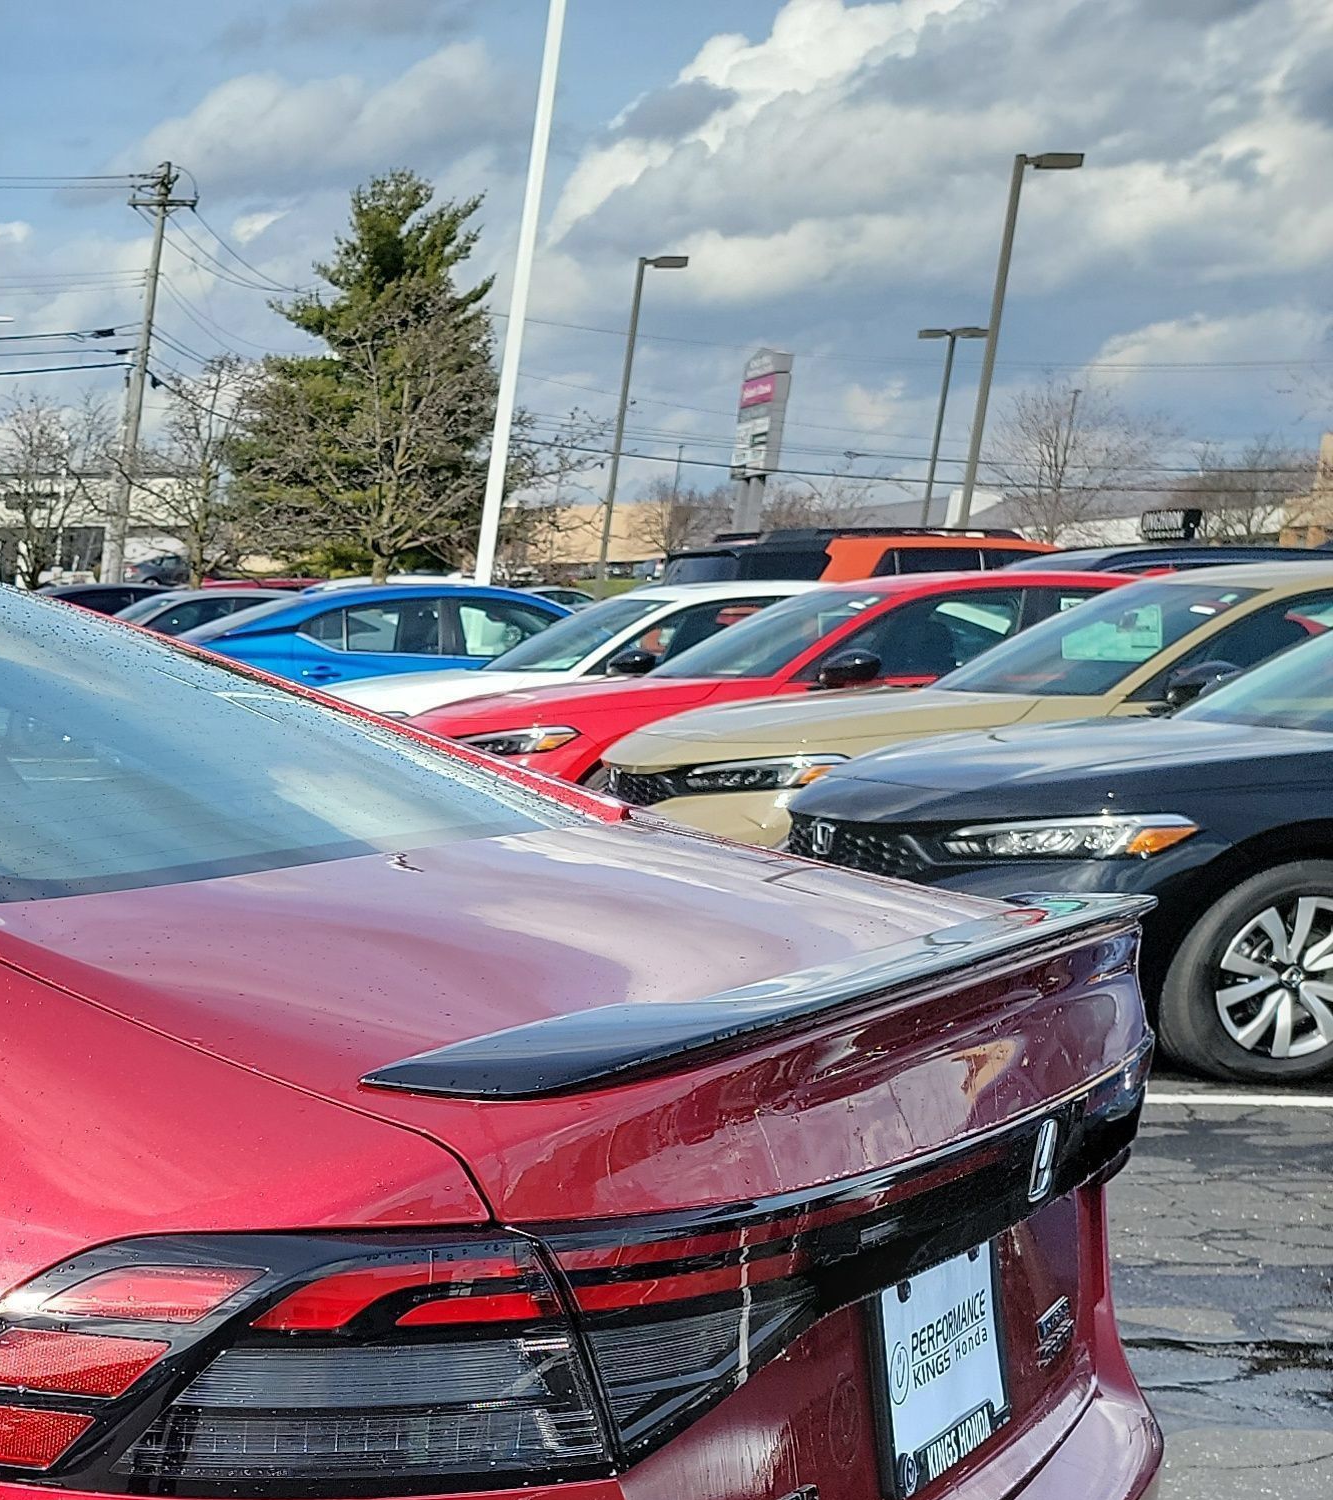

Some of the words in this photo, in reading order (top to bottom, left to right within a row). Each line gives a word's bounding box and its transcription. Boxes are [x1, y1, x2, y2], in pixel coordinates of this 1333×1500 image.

[911, 1288, 986, 1362] PERFORMANCE
[912, 1349, 951, 1389] KINGS
[955, 1326, 988, 1362] Honda
[926, 1430, 959, 1481] KINGS
[958, 1406, 992, 1458] HONDA
